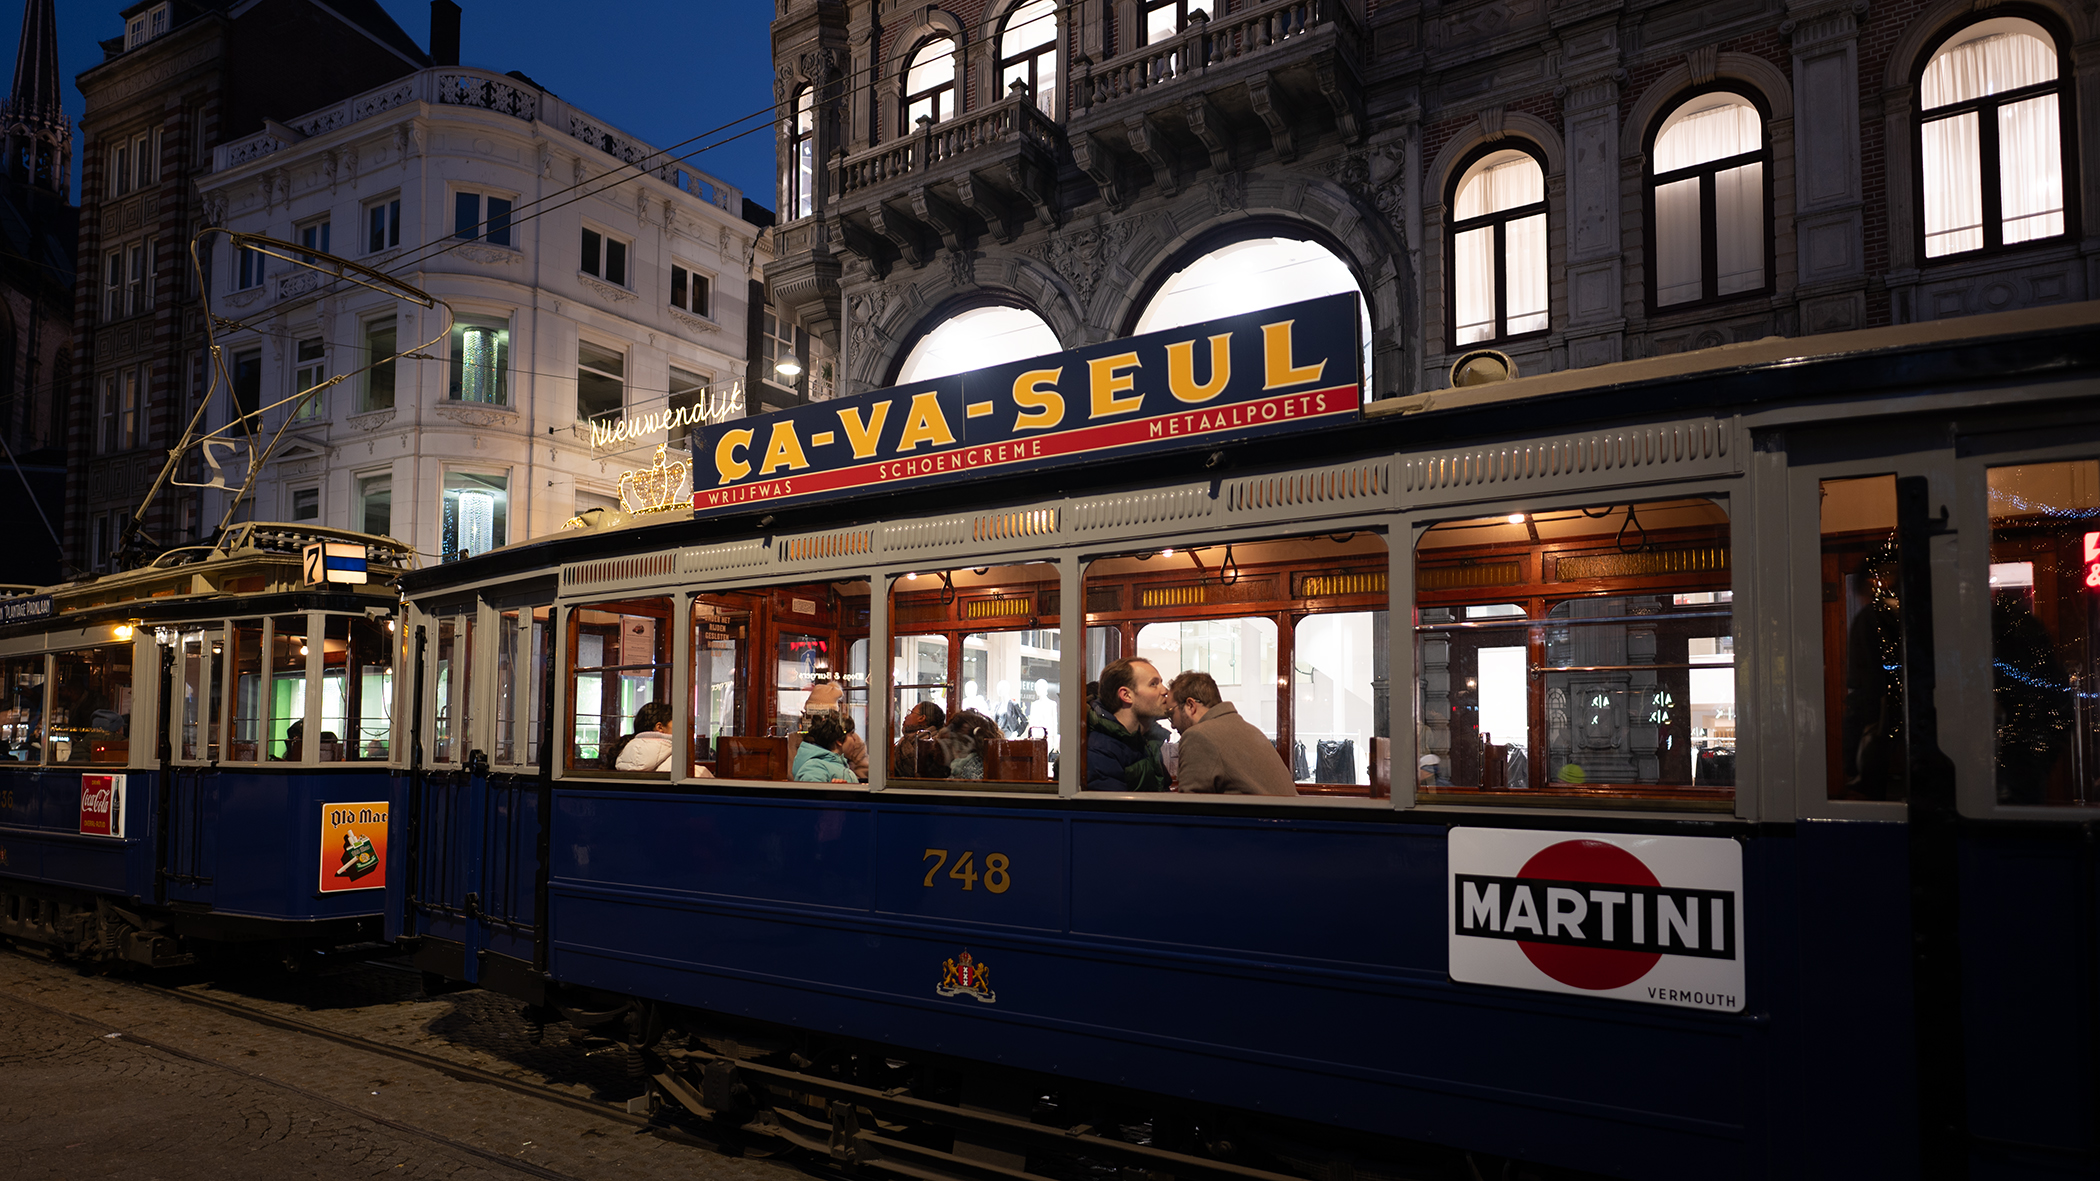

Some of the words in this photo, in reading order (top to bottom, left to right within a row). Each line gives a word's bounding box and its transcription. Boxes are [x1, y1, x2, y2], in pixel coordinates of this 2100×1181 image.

[715, 319, 1328, 484] ÇA-VA-SEUL
[1149, 393, 1327, 438] METAALPOETS
[879, 440, 1042, 480] SCHOENCREME
[708, 480, 793, 505] WRIJFWAS
[306, 546, 320, 584] 7
[704, 631, 730, 640] GESLOTEN
[0, 790, 14, 809] 36
[330, 808, 356, 829] Old
[922, 848, 1011, 894] 748
[1462, 880, 1725, 951] MARTINI
[1647, 986, 1736, 1008] VERMOUTH
